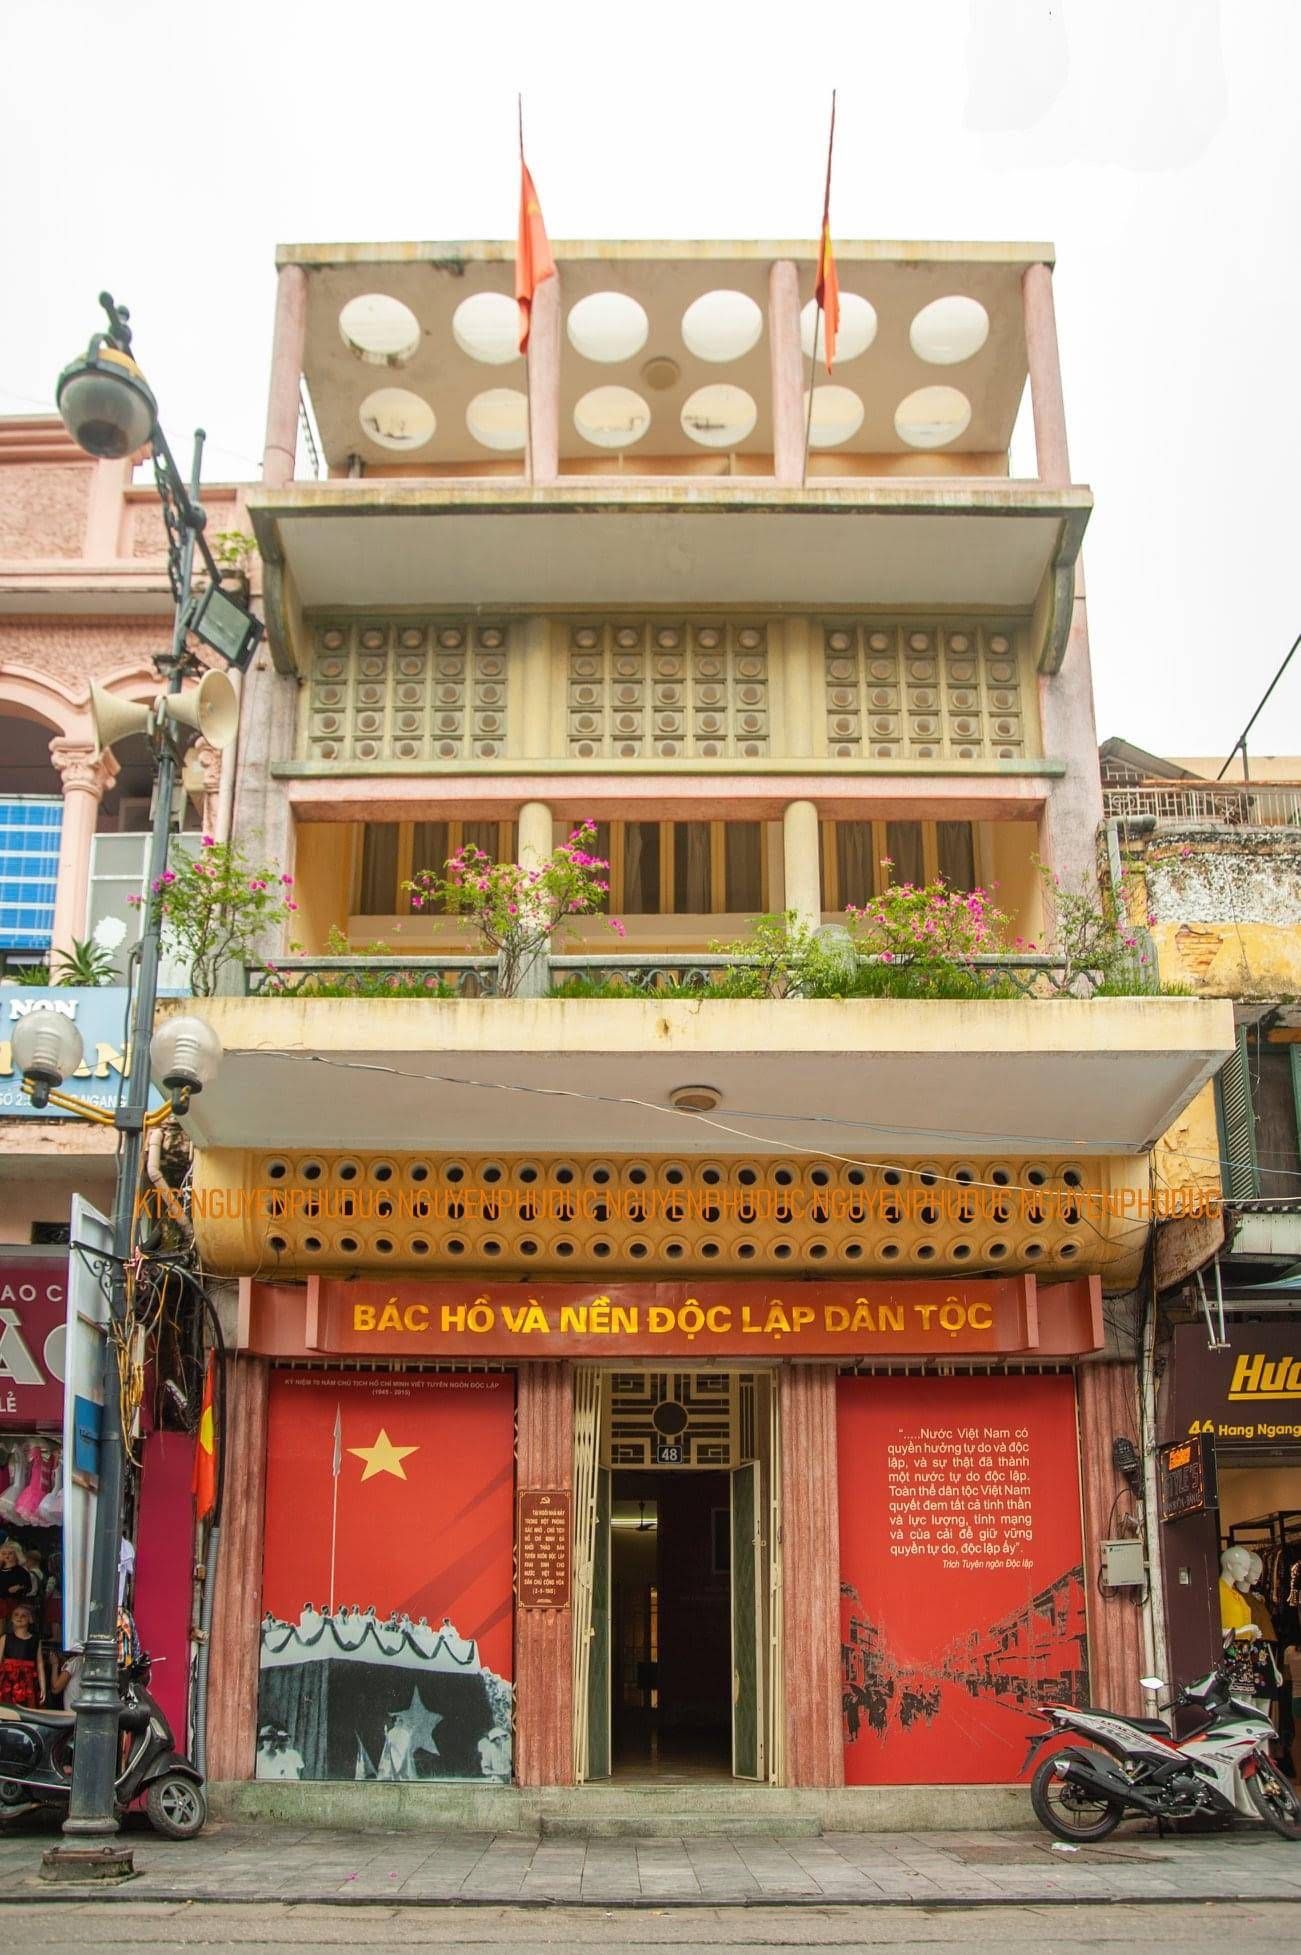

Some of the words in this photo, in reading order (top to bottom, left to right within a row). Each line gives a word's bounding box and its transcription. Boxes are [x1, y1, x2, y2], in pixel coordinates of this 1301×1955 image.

[354, 1297, 429, 1332] BÁC
[441, 1294, 495, 1332] HỒ
[502, 1299, 550, 1333] VÀ
[560, 1296, 638, 1333] NỀN
[647, 1299, 732, 1340] ĐỘC
[742, 1300, 815, 1339] LẬP
[825, 1298, 904, 1332] DÂN
[914, 1296, 993, 1337] TỘC
[957, 1429, 979, 1440] Việt
[984, 1429, 1010, 1439] Nam
[1015, 1428, 1028, 1438] có
[1218, 1424, 1254, 1438] Hang
[1258, 1424, 1301, 1438] Ngang
[662, 1448, 678, 1460] 48
[888, 1441, 922, 1455] quyền
[924, 1442, 961, 1455] hưởng
[964, 1443, 975, 1454] tự
[978, 1443, 991, 1452] do
[993, 1442, 1006, 1452] và
[1008, 1442, 1029, 1454] độc
[888, 1457, 908, 1469] lập,
[914, 1457, 927, 1468] và
[932, 1459, 947, 1469] sự
[953, 1458, 974, 1469] thật
[979, 1457, 992, 1467] đã
[999, 1457, 1029, 1467] thành
[888, 1472, 910, 1483] một
[914, 1471, 944, 1482] nước
[950, 1472, 961, 1483] tự
[966, 1472, 980, 1482] do
[985, 1471, 1005, 1483] độc
[1010, 1470, 1030, 1483] lập.
[888, 1485, 916, 1496] Toàn
[919, 1483, 936, 1496] thể
[939, 1485, 959, 1496] dân
[962, 1485, 978, 1497] tộc
[980, 1485, 1002, 1497] Việt
[1004, 1485, 1030, 1495] Nam
[889, 1498, 920, 1513] quyết
[923, 1500, 947, 1510] đem
[950, 1498, 965, 1510] tất
[968, 1499, 980, 1510] cả
[984, 1499, 1006, 1510] tinh
[1007, 1497, 1031, 1509] thần
[890, 1514, 903, 1525] và
[909, 1514, 927, 1527] lực
[932, 1514, 968, 1527] lượng,
[974, 1514, 995, 1525] tính
[1000, 1515, 1032, 1526] mạng
[890, 1529, 903, 1539] và
[910, 1529, 930, 1539] của
[937, 1529, 952, 1539] cải
[959, 1527, 973, 1539] để
[979, 1529, 997, 1541] giữ
[1004, 1528, 1032, 1540] vững
[890, 1541, 925, 1556] quyền
[928, 1544, 939, 1556] tự
[942, 1543, 958, 1554] do,
[961, 1543, 982, 1555] độc
[984, 1543, 1000, 1555] lập
[943, 1560, 959, 1568] Trích
[962, 1560, 984, 1569] Tuyên
[986, 1560, 1004, 1569] ngôn
[1006, 1559, 1021, 1568] Độc
[1022, 1559, 1033, 1569] lập
